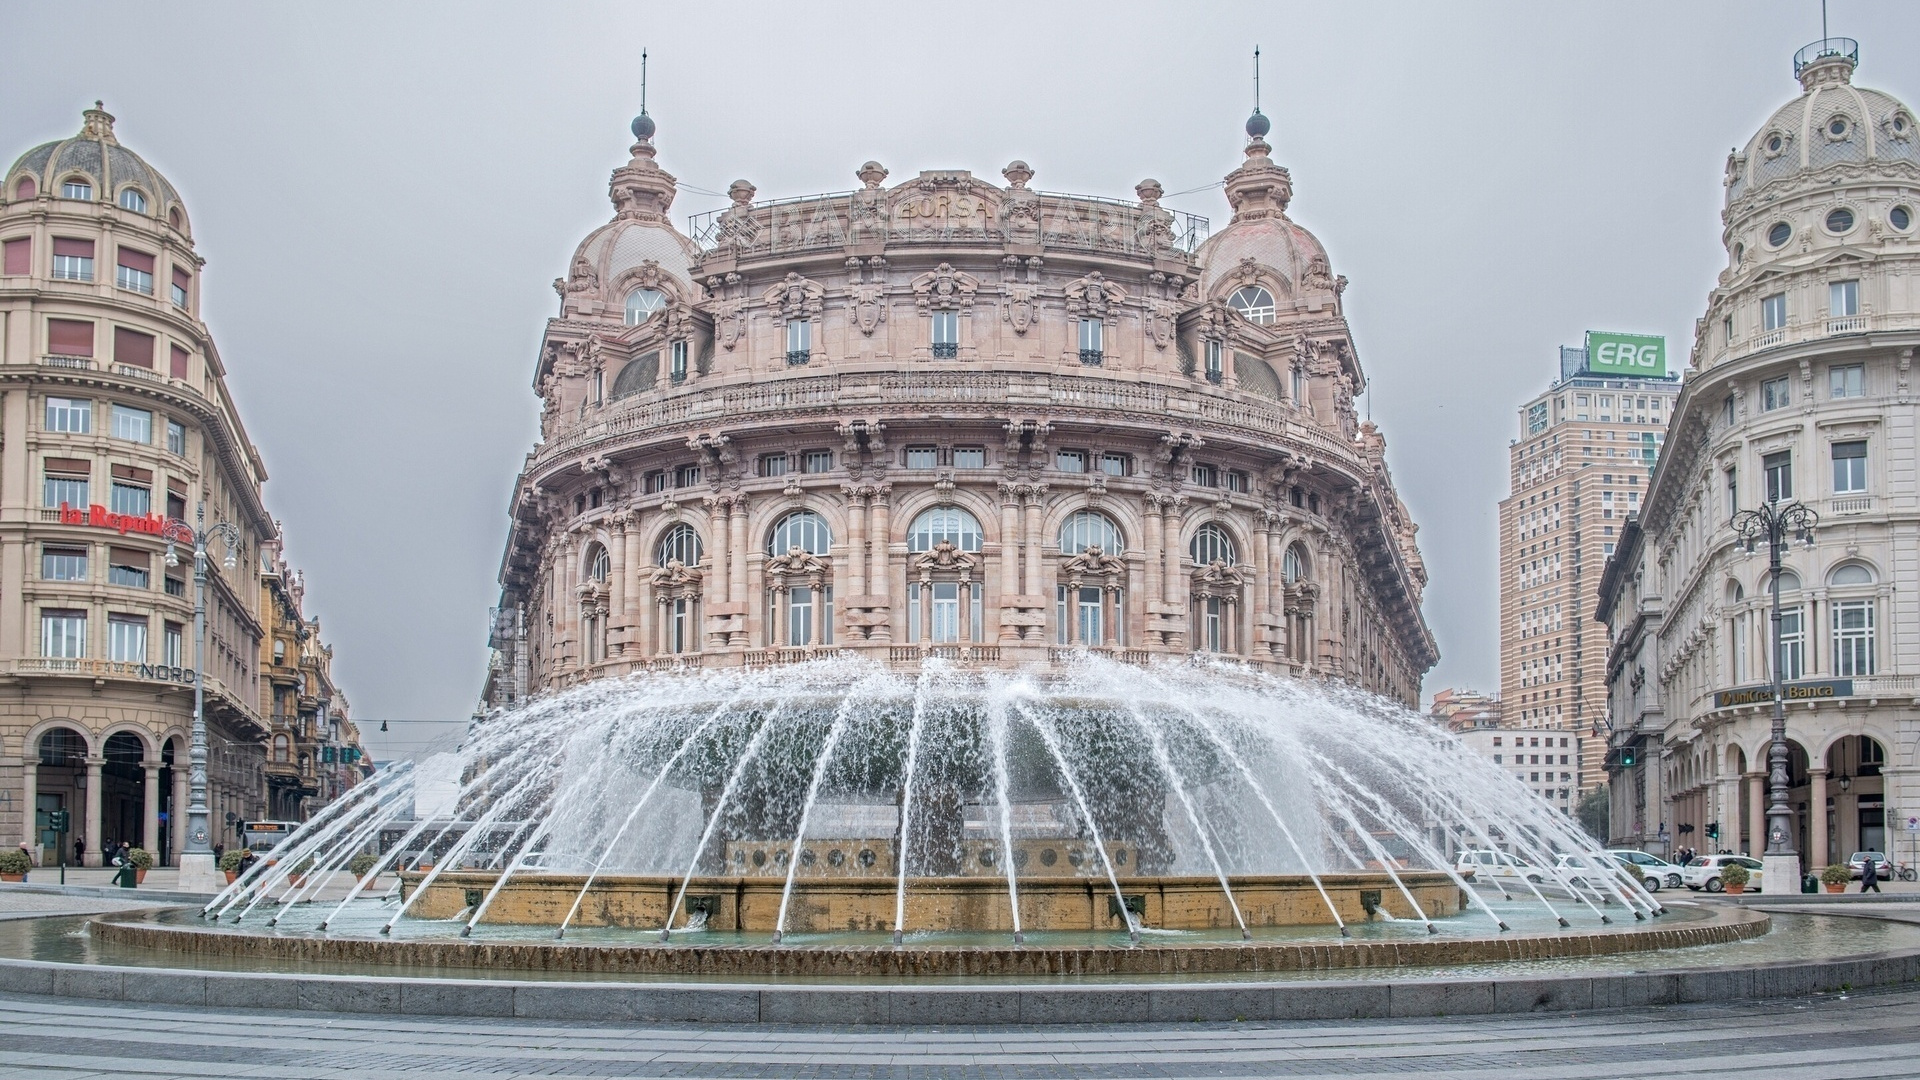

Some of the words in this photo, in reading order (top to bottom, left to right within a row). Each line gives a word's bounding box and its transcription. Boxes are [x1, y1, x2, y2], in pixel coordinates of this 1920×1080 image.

[898, 195, 993, 219] BORSA
[1597, 342, 1658, 368] ERG
[60, 501, 82, 525] la
[1733, 687, 1786, 704] UniCret
[1789, 685, 1834, 699] Banca
